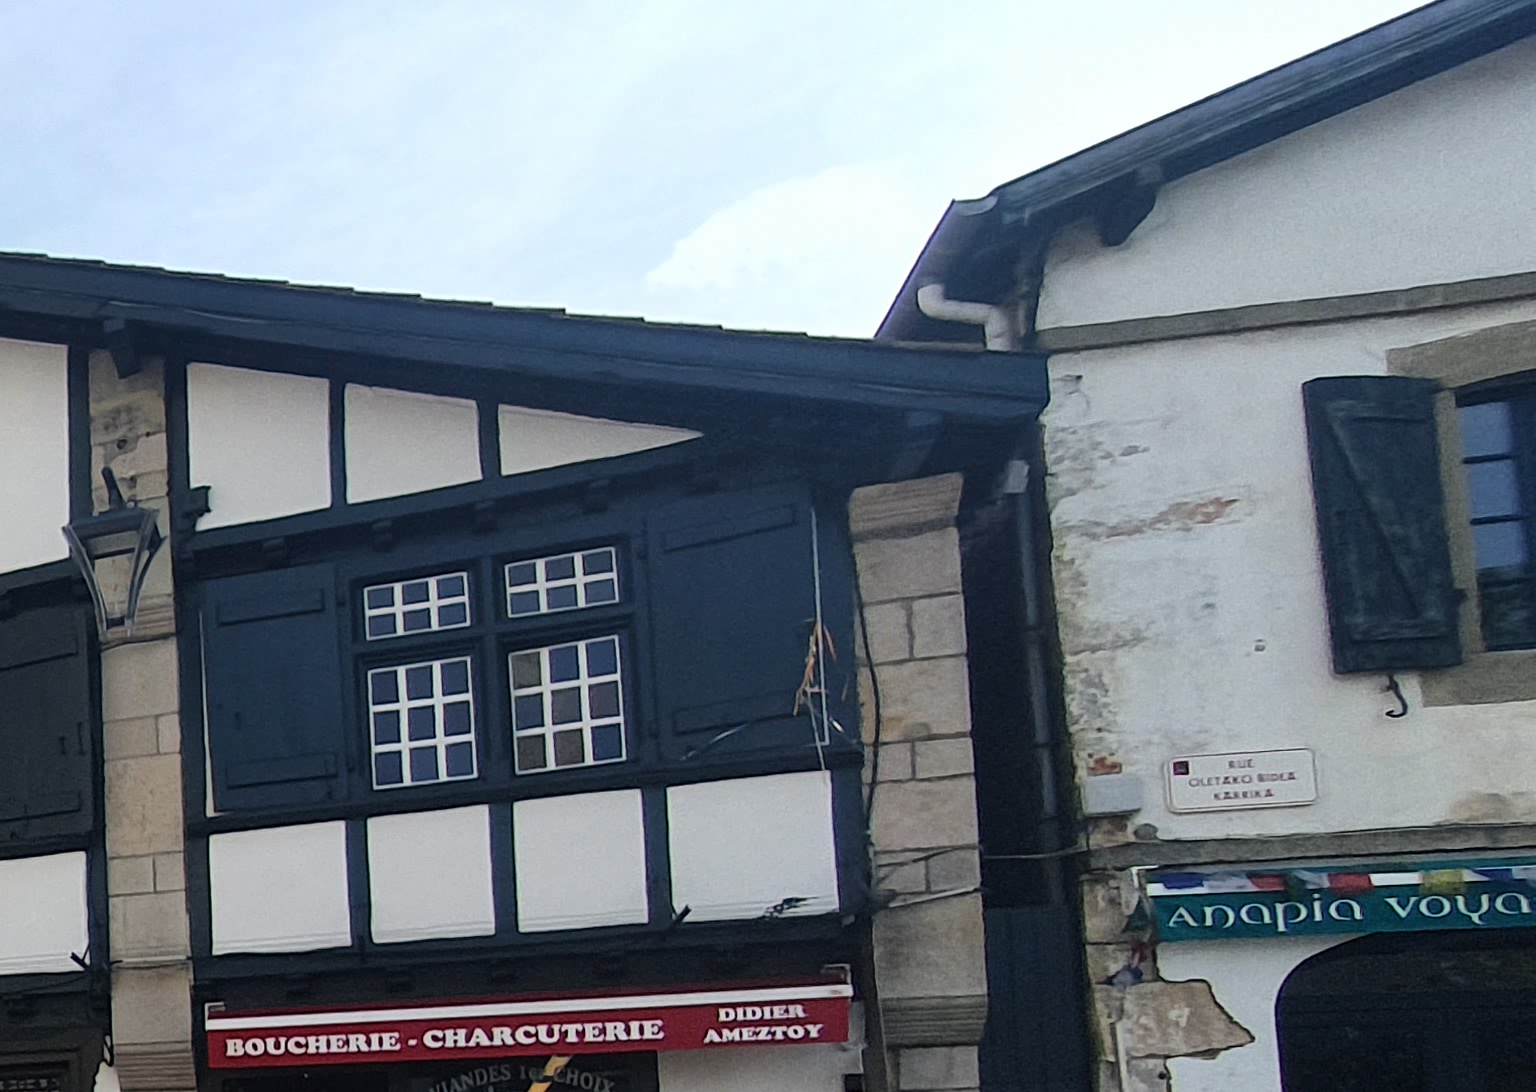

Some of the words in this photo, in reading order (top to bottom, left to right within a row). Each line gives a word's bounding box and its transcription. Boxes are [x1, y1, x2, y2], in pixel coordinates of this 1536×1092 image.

[1228, 758, 1255, 769] RUE
[1188, 774, 1253, 788] OLETAKO
[1257, 771, 1298, 783] BIDEA
[1213, 788, 1275, 801] KARRIKA
[717, 1003, 809, 1023] DIDIER
[225, 1031, 401, 1057] BOUCHERIE
[422, 1019, 665, 1049] CHARCUTERIE
[703, 1023, 824, 1044] AMEZTOY
